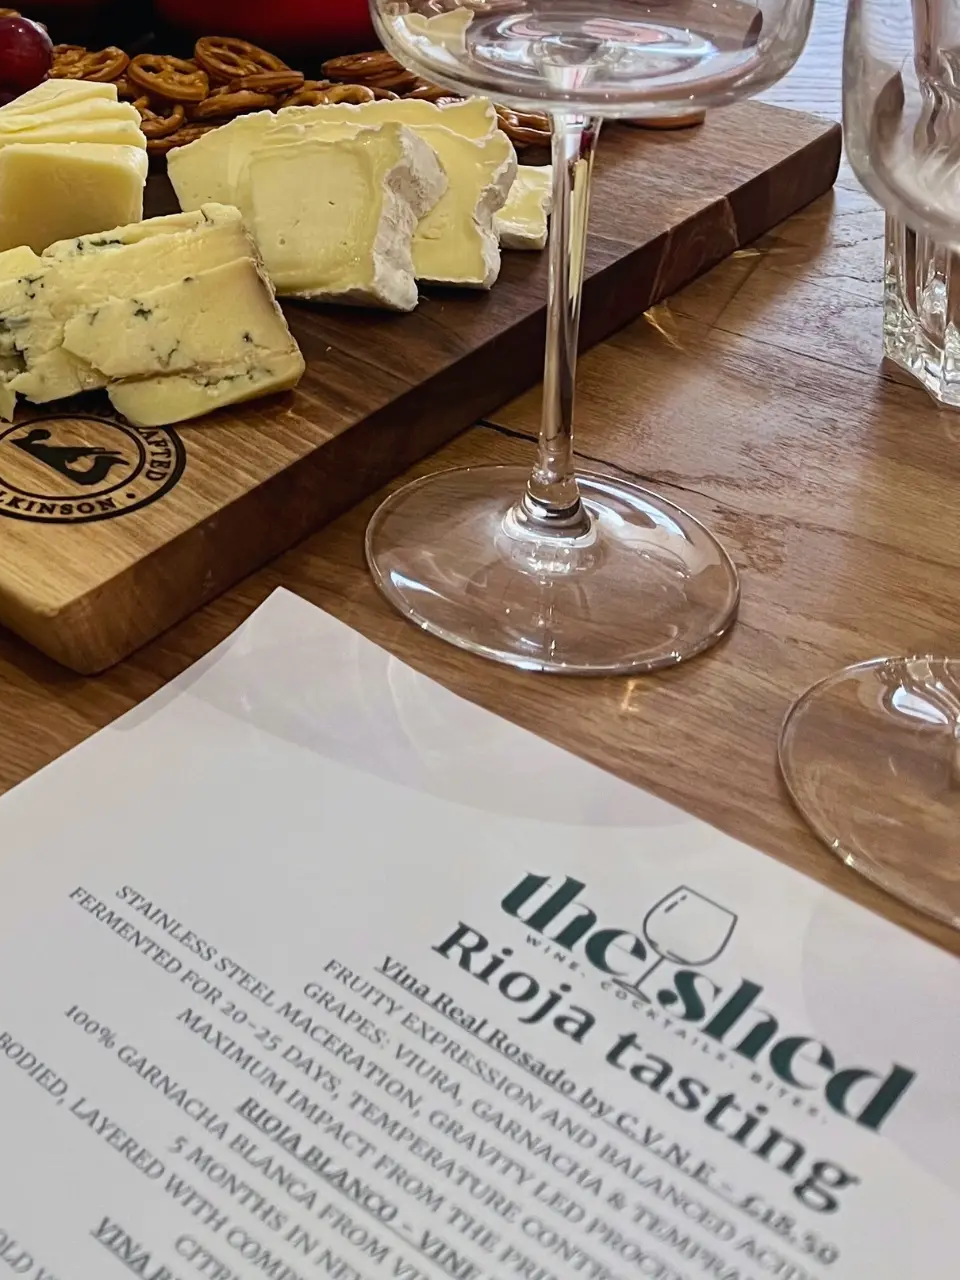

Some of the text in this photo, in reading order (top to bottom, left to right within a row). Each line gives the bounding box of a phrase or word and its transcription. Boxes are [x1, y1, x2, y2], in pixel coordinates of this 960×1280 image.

[69, 886, 182, 974] FERMENTED
[180, 969, 223, 1005] FOR
[281, 1044, 342, 1101] DAYS,
[349, 1089, 522, 1223] TEMPERATURE
[115, 884, 218, 962] STAINLESS
[213, 957, 276, 1007] STEEL
[275, 1001, 423, 1118] MACERATION,
[428, 1109, 536, 1186] GRAVITY
[532, 1180, 586, 1223] LED
[303, 982, 391, 1049] GRAPES:
[394, 1042, 464, 1107] VIURA,
[471, 1098, 604, 1196] GARNACHA
[607, 1190, 627, 1211] &
[323, 958, 404, 1016] FRUITY
[400, 1011, 542, 1113] EXPRESSION
[541, 1109, 599, 1149] AND
[598, 1144, 737, 1241] BALANCED
[431, 920, 861, 1214] Rioja tasting
[432, 992, 489, 1037] Real
[487, 1028, 577, 1095] Rosado
[580, 1088, 614, 1118] by
[500, 871, 917, 1133] the shed
[64, 1005, 390, 1265] 100% GARNACHA BLANCA FROM
[69, 1097, 165, 1180] LAYERED
[164, 1172, 229, 1233] WITH
[91, 1216, 151, 1274] VINA
[169, 1135, 188, 1154] 5
[185, 1147, 290, 1232] MONTHS
[285, 1225, 320, 1256] IN
[176, 1007, 287, 1096] MAXIMUM
[284, 1088, 377, 1160] IMPACT
[374, 1154, 446, 1214] FROM
[447, 1203, 501, 1255] THE
[236, 1097, 302, 1156] RIOJA
[301, 1144, 399, 1224] BLANCO
